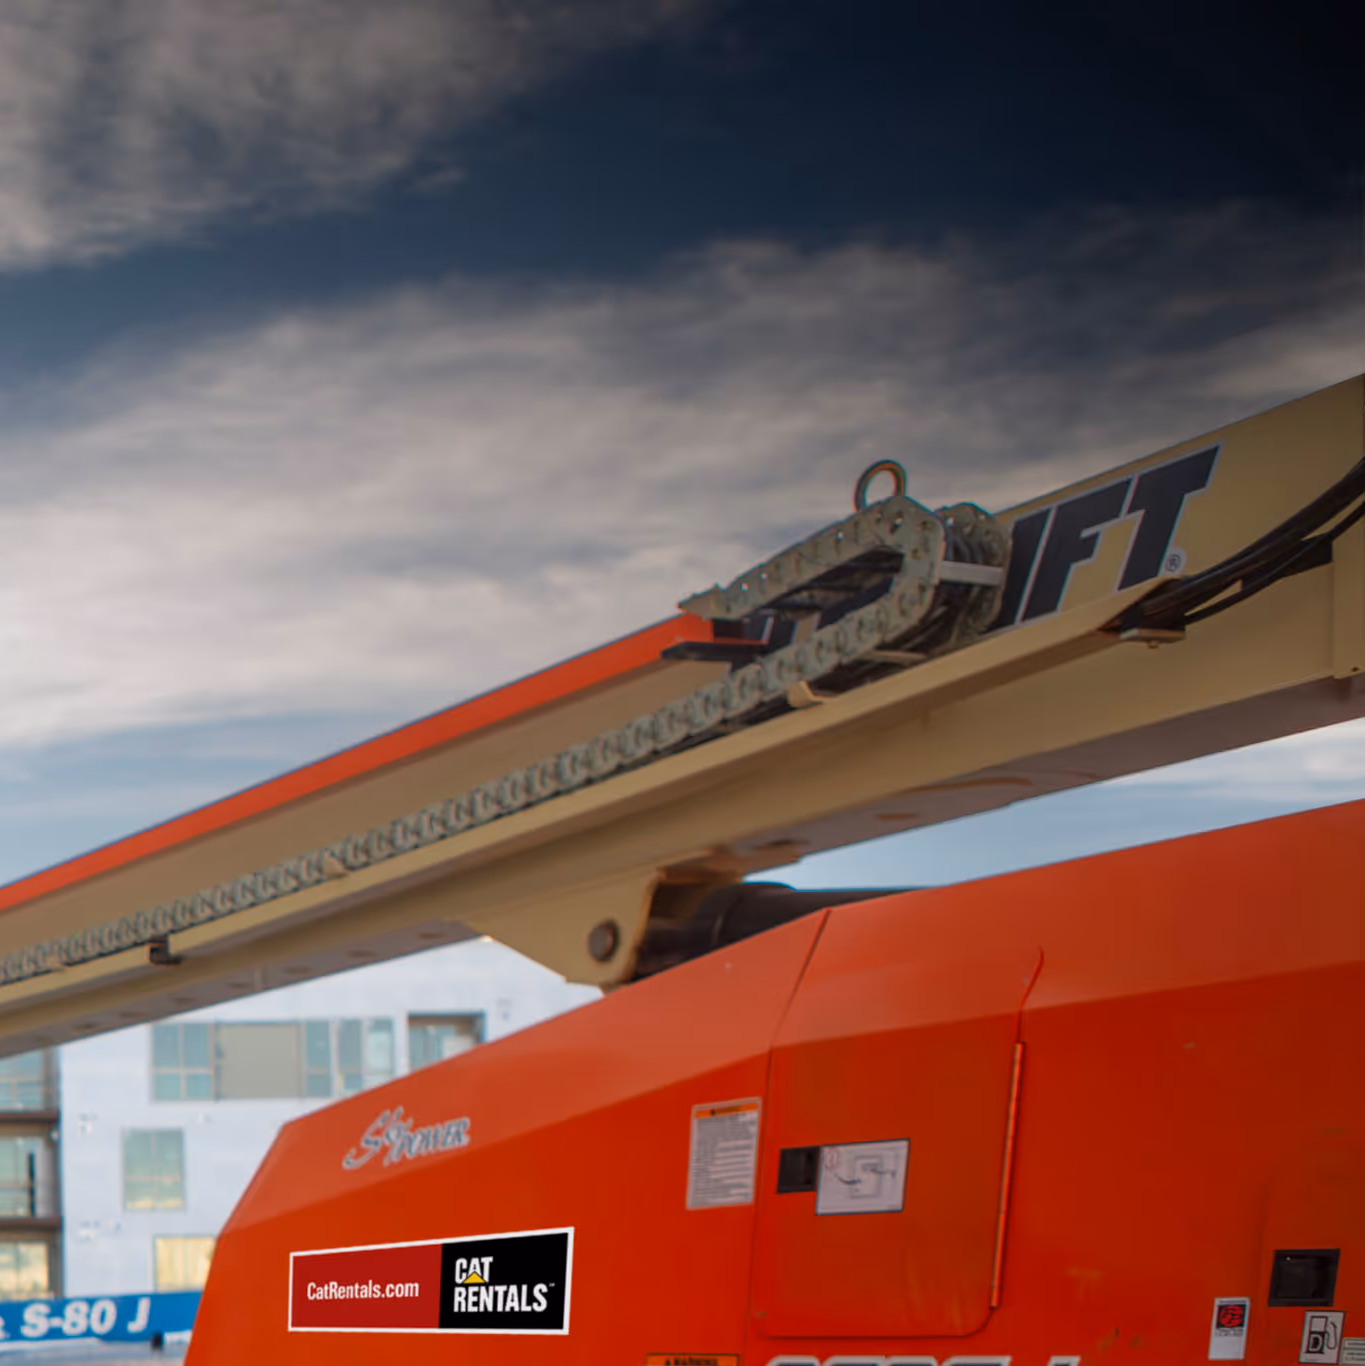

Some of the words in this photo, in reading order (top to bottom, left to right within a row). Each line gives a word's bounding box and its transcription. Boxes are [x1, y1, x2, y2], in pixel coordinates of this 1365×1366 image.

[454, 1256, 494, 1284] CAT
[307, 1279, 420, 1300] CatRentals.com
[453, 1283, 550, 1313] RENTALS
[20, 1298, 118, 1338] S-80
[127, 1296, 152, 1333] J
